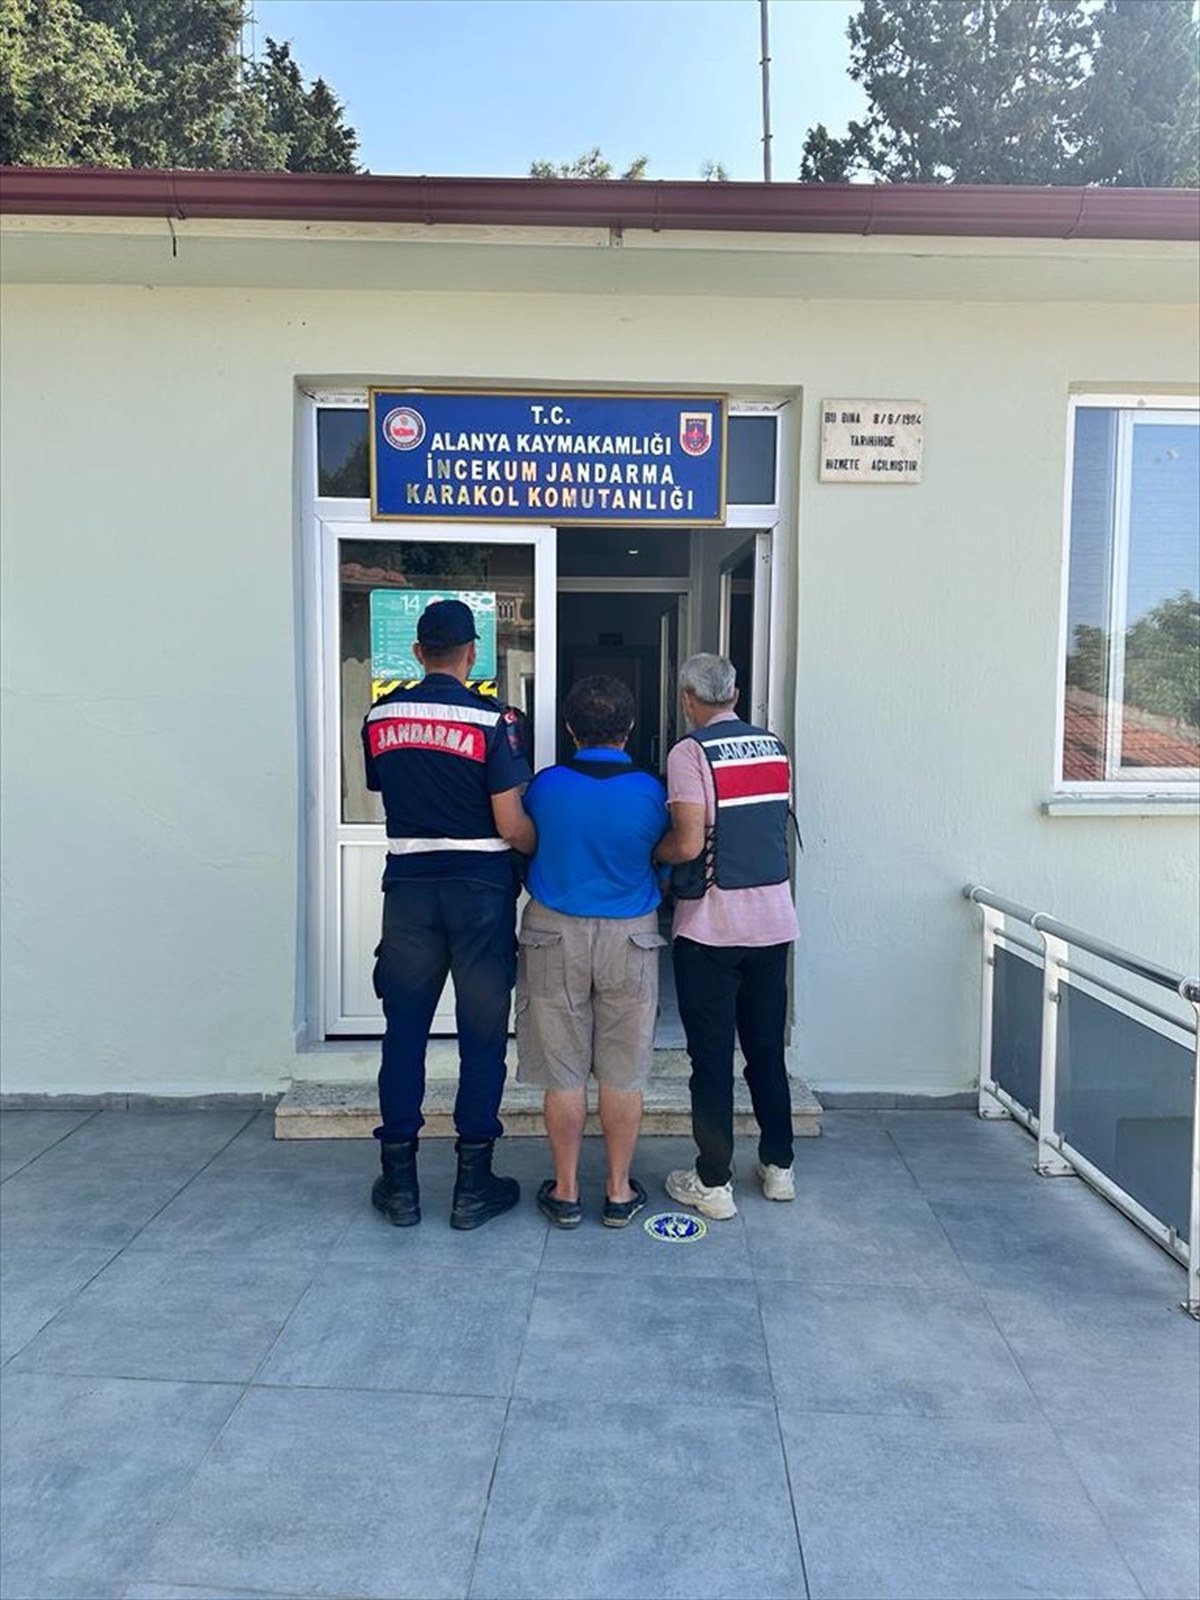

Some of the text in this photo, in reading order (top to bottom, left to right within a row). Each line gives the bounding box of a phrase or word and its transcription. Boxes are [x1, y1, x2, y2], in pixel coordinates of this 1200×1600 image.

[531, 406, 571, 425] T.C.
[824, 412, 837, 423] BU
[430, 433, 672, 455] ALANYA KAYMAKAMLIĞI
[427, 453, 675, 485] İNCEKUM JANDARMA
[406, 483, 693, 510] KARAKOL KOMUTANLIĞI
[400, 594, 420, 611] 14
[377, 722, 475, 756] JANDARMA
[718, 740, 781, 761] JANDARMA
